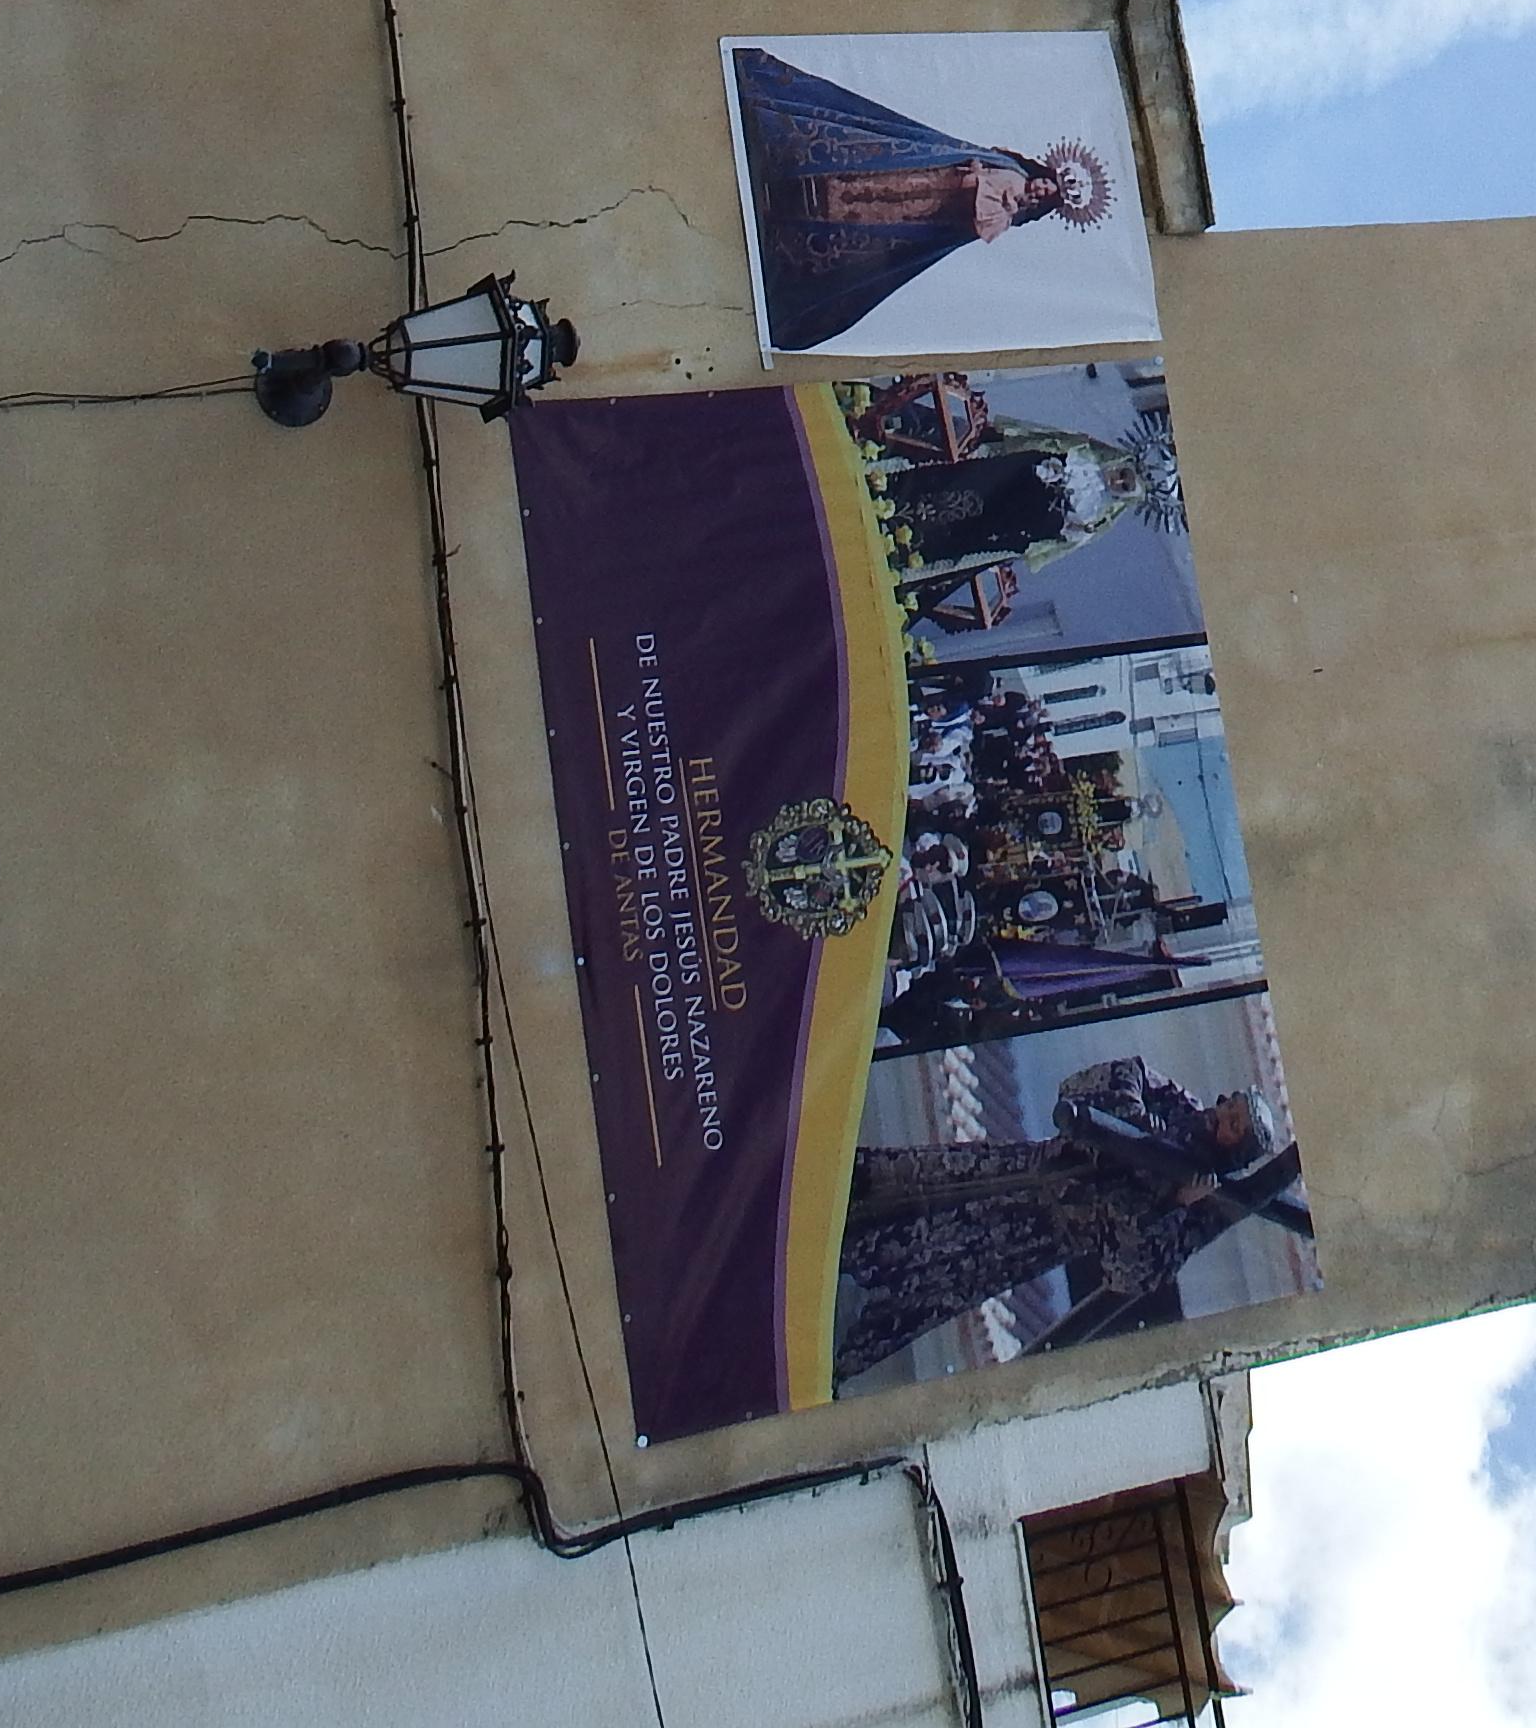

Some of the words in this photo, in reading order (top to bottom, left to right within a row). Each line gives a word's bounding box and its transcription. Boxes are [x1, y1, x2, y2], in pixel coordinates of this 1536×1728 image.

[635, 634, 657, 668] DE
[616, 705, 636, 720] Y
[641, 679, 675, 805] NUESTRO
[619, 730, 651, 834] VIRGEN
[607, 829, 628, 864] DE
[633, 846, 656, 880] DE
[658, 815, 688, 899] PADRE
[689, 757, 747, 1011] HERMANDAD
[612, 873, 643, 962] ANTAS
[640, 892, 665, 940] LOS
[668, 911, 701, 984] JESÚS
[648, 953, 683, 1081] DOLORES
[685, 996, 724, 1150] NAZARENO
